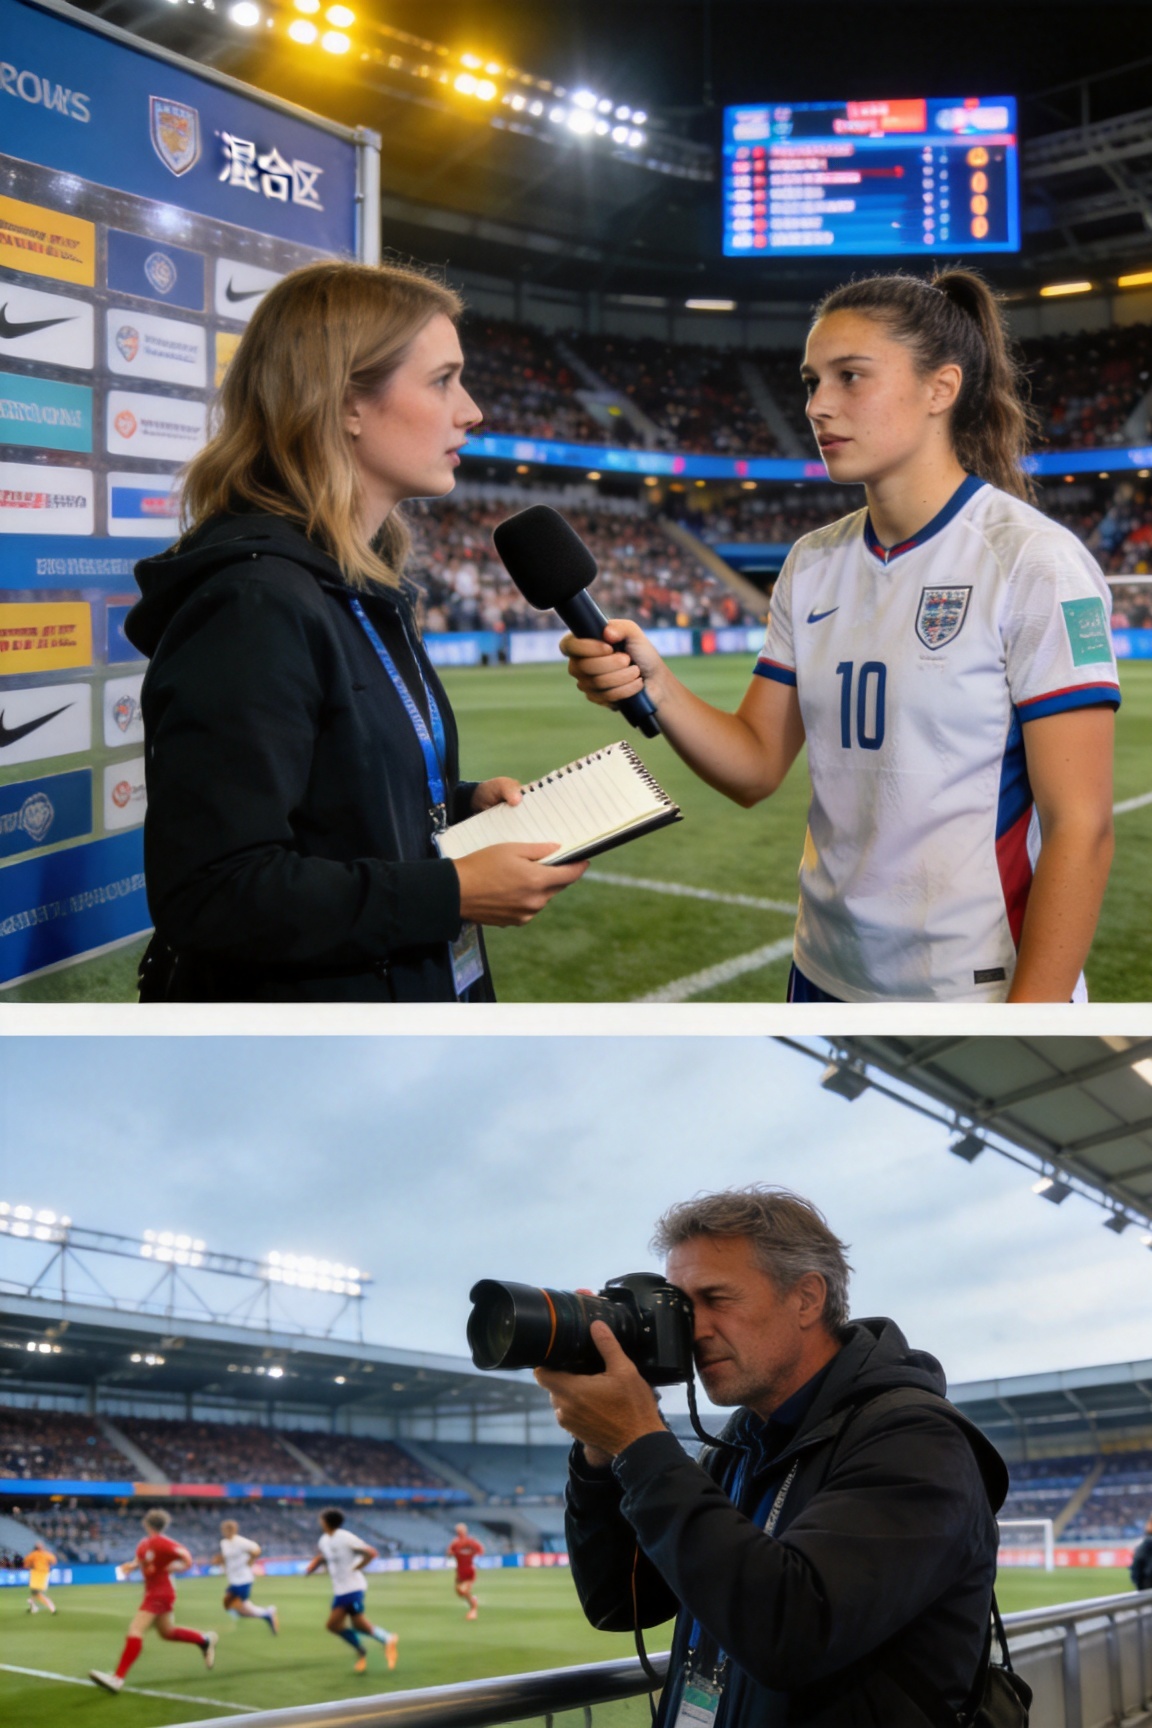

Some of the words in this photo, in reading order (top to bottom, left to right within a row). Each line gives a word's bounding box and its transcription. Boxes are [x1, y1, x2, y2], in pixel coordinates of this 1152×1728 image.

[214, 131, 325, 212] 混合区
[836, 661, 887, 750] 10
